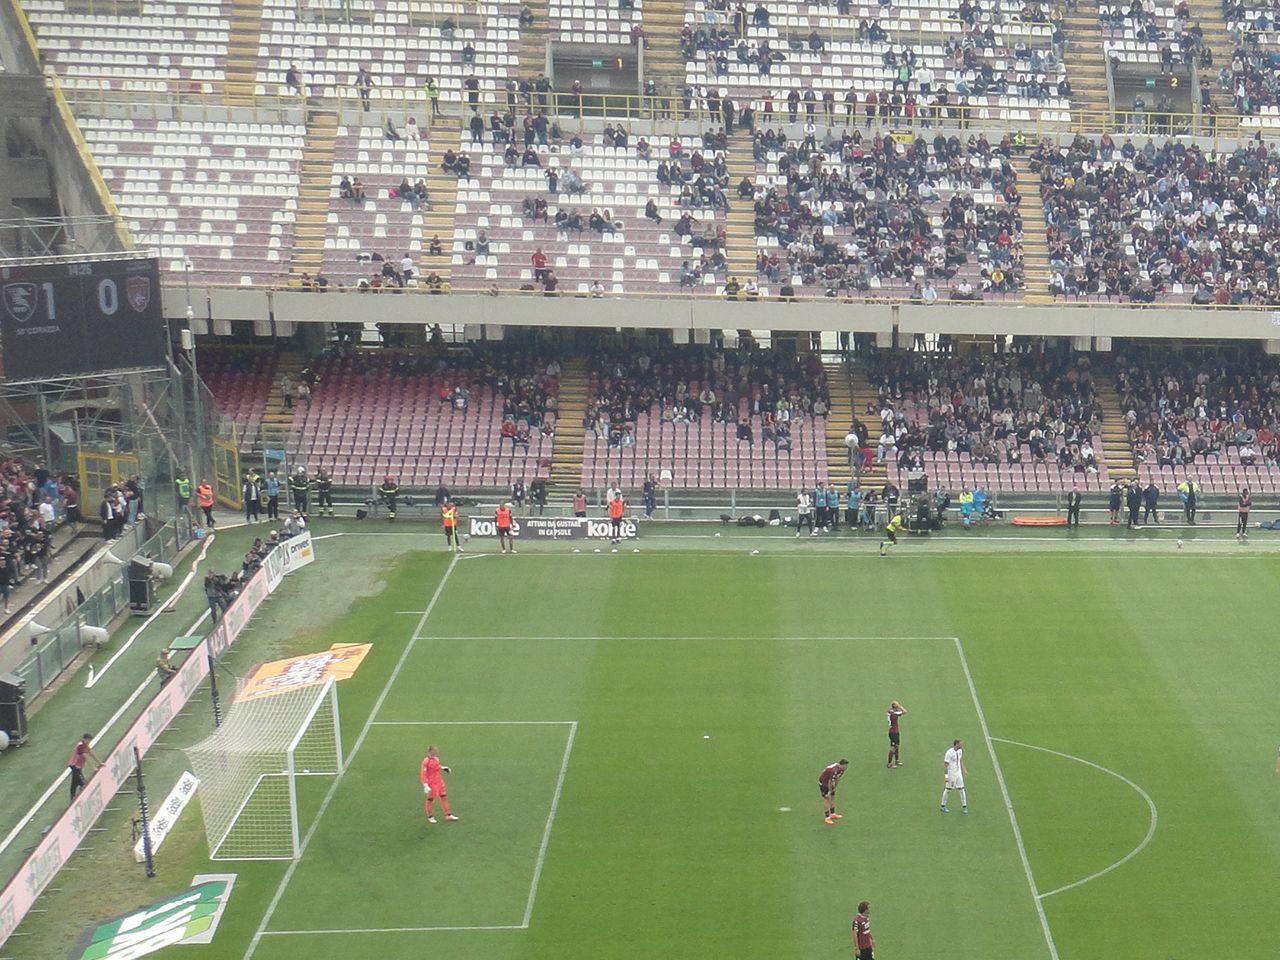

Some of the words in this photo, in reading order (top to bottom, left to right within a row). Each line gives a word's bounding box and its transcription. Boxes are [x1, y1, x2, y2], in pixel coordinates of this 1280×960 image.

[1171, 77, 1178, 87] 2
[42, 282, 56, 320] 1
[98, 278, 119, 315] 0
[556, 520, 582, 528] GUSTARE
